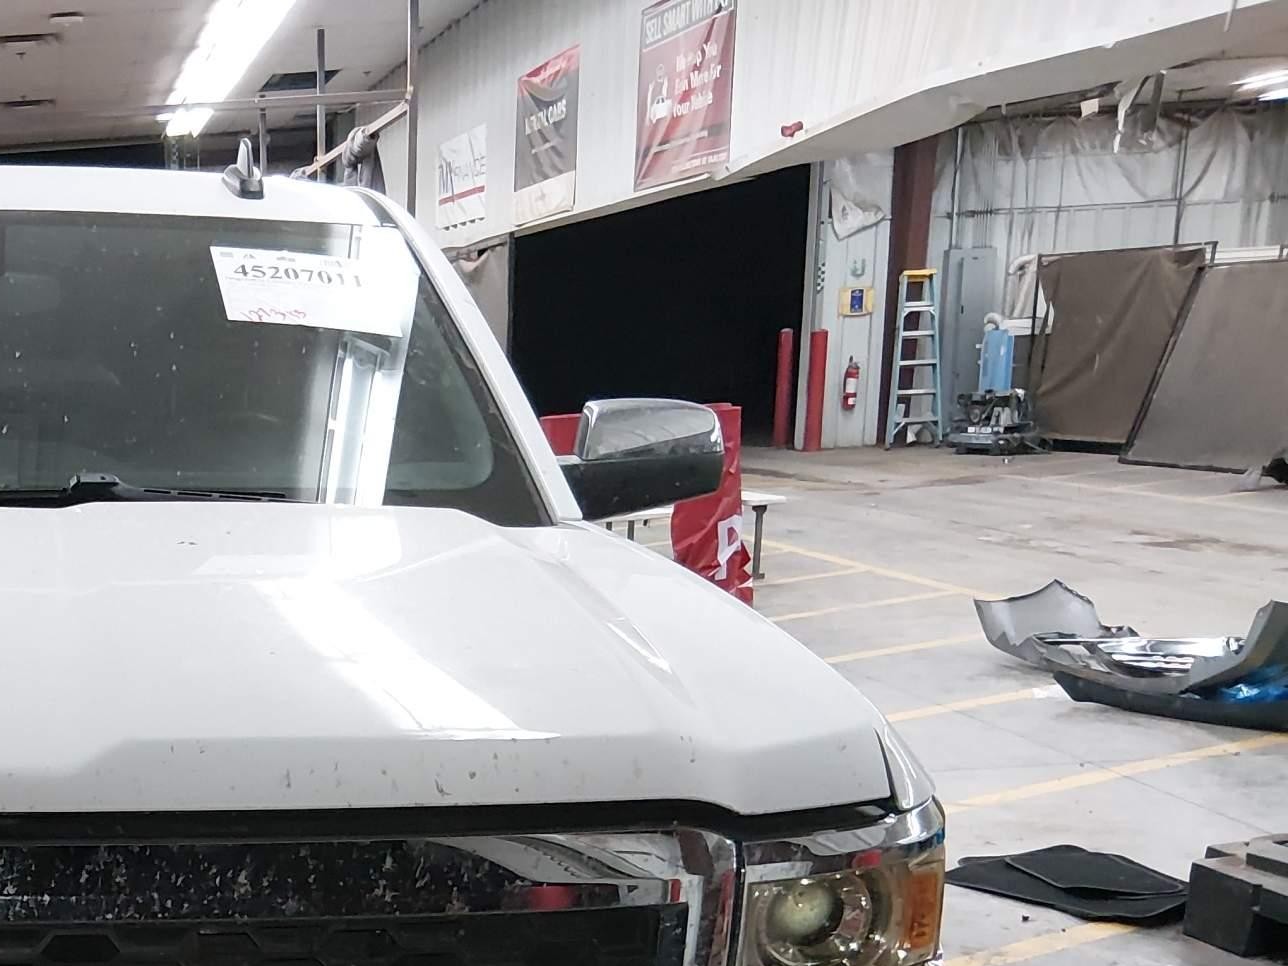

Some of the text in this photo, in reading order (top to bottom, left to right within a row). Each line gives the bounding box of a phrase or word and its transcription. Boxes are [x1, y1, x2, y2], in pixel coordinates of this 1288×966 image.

[645, 16, 662, 44] SELL
[663, 1, 691, 36] SMART
[548, 98, 567, 125] CARS
[673, 102, 691, 118] Your
[233, 263, 362, 287] 45207011
